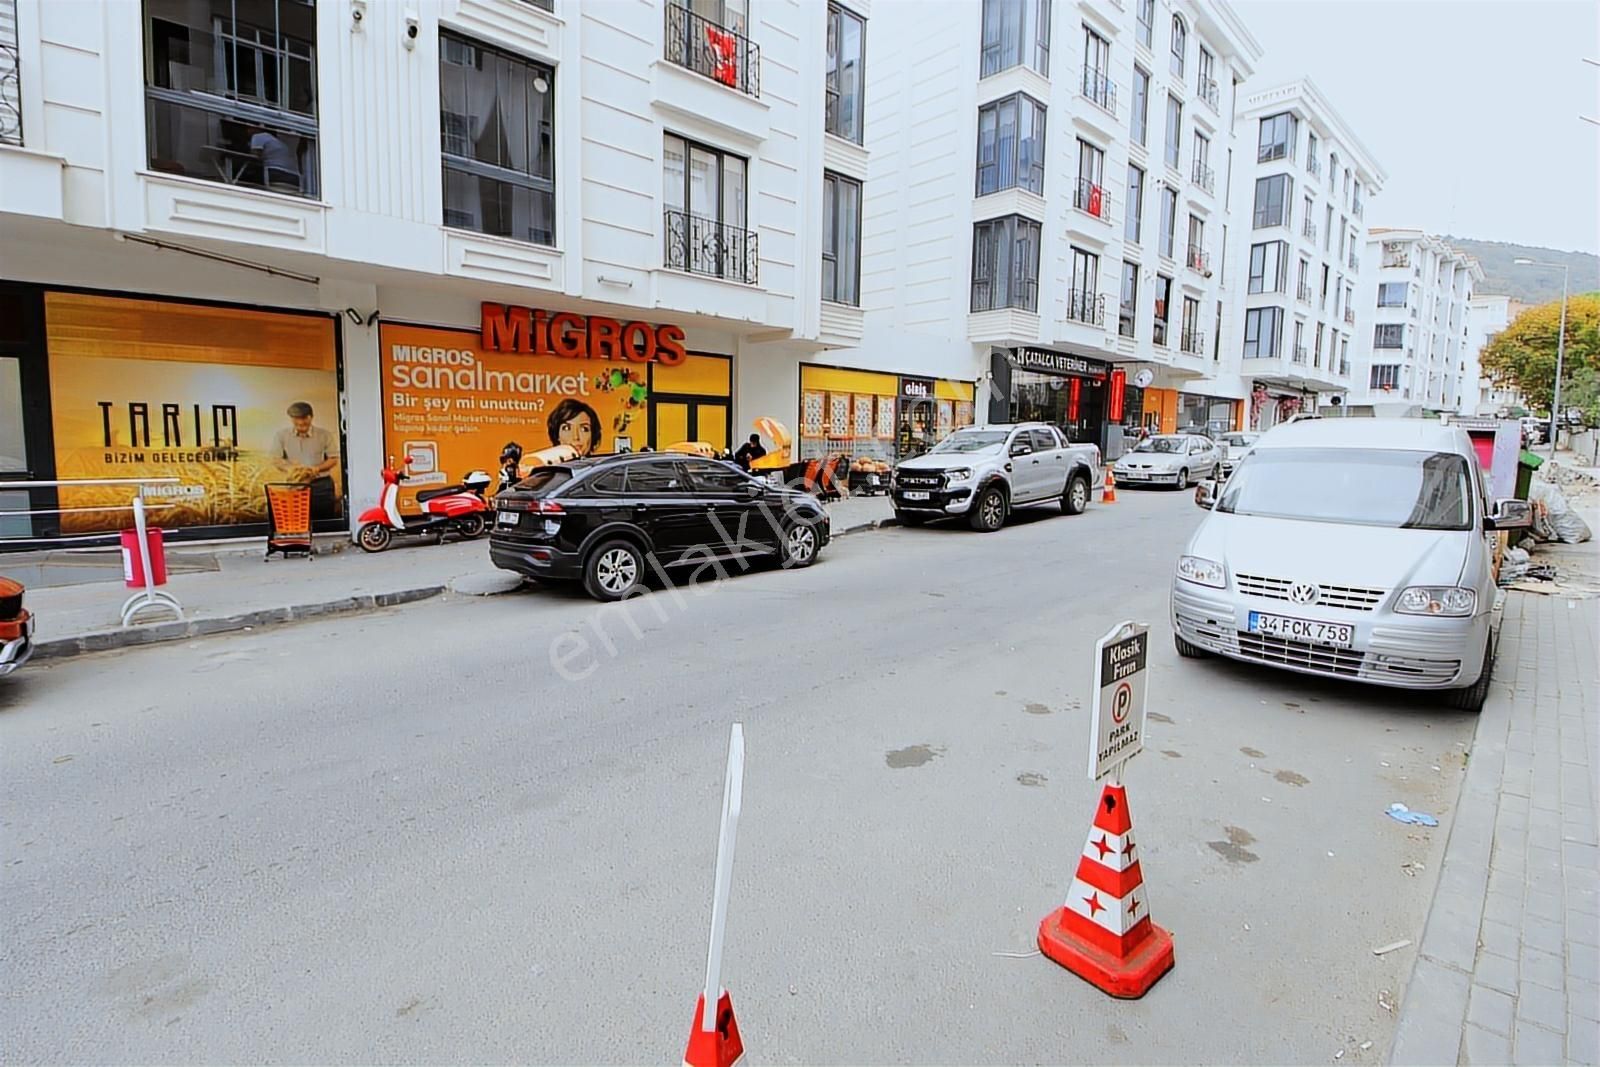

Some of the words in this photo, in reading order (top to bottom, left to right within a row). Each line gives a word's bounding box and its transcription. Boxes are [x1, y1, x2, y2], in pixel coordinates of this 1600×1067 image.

[392, 361, 590, 396] sanalmarket
[392, 392, 418, 407] Bir
[424, 397, 450, 411] şey
[456, 395, 475, 409] mi
[480, 398, 545, 412] unuttun?
[97, 402, 239, 447] TARIM
[105, 452, 145, 463] BİZİM
[1259, 615, 1277, 631] 34
[1282, 619, 1311, 637] FCK
[1317, 624, 1348, 642] 758
[1109, 638, 1141, 665] Klasik
[1109, 723, 1131, 743] PARK
[1098, 731, 1139, 763] YAPILMAZ
